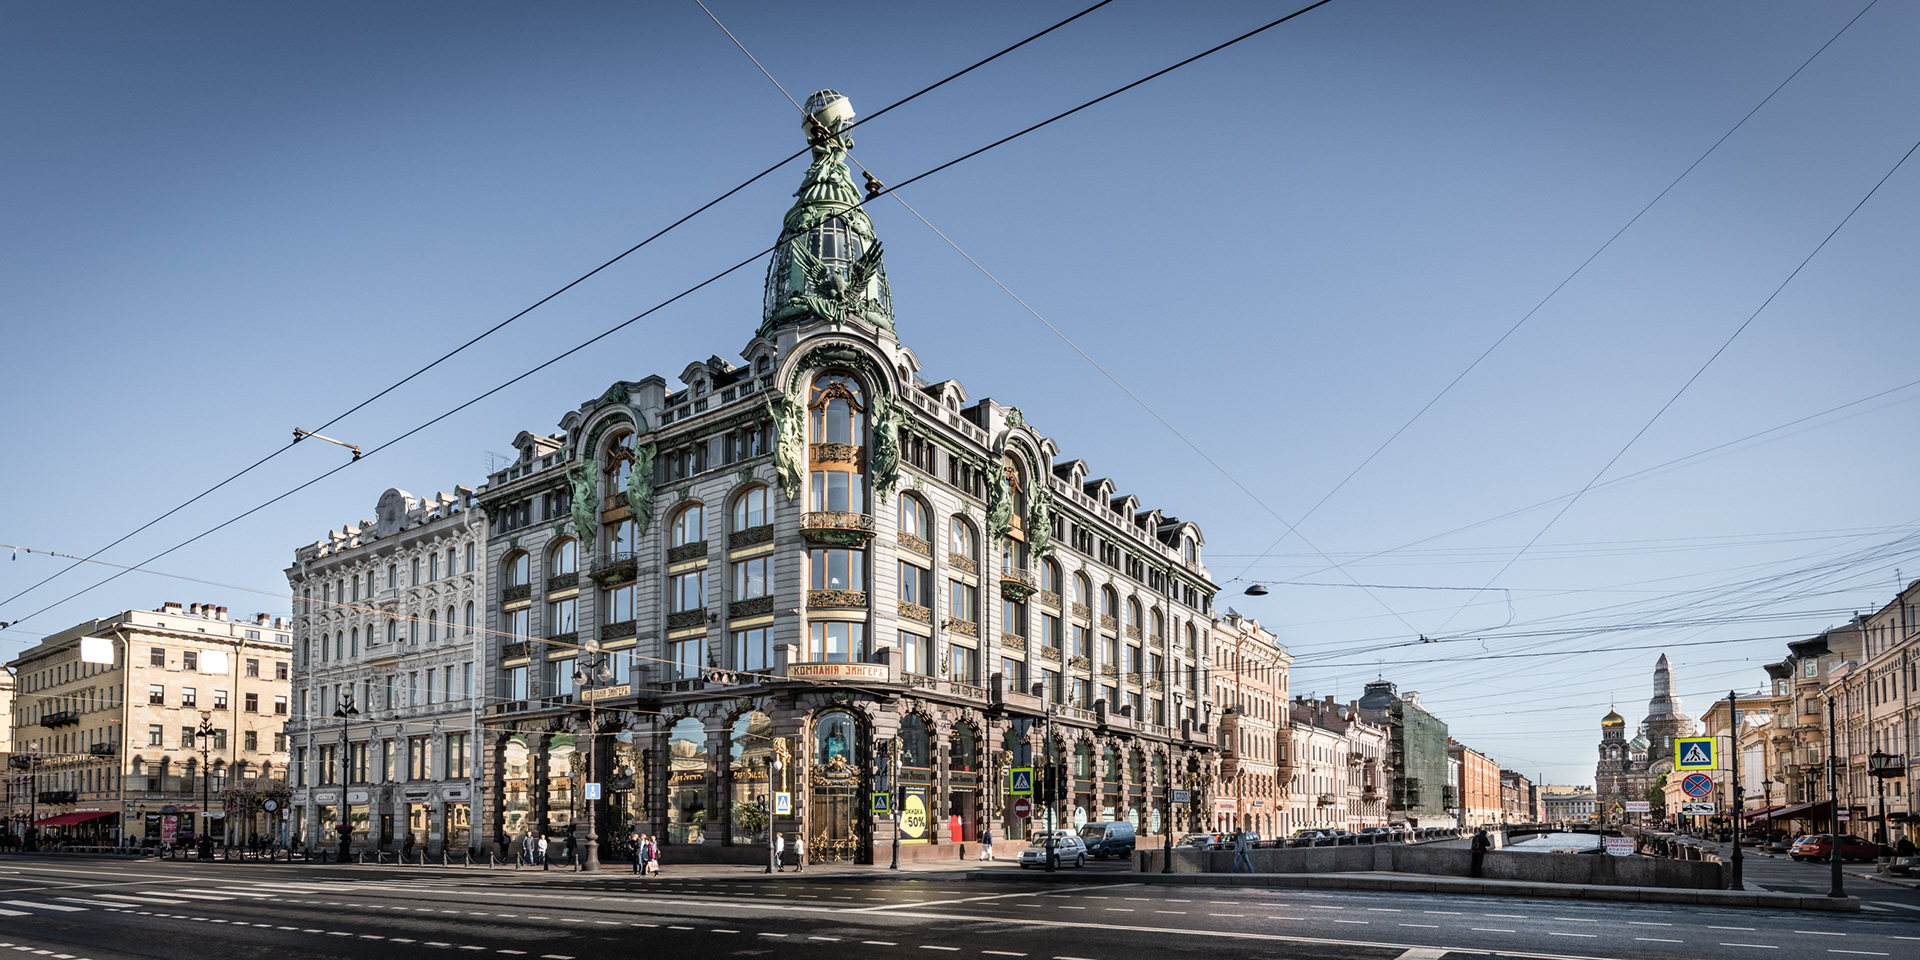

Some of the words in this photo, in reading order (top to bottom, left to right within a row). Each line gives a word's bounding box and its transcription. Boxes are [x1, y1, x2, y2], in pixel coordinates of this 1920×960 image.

[794, 666, 839, 676] КОМПАНІЯ
[846, 666, 884, 677] ЗИНГЕРЪ
[908, 816, 925, 828] 50%
